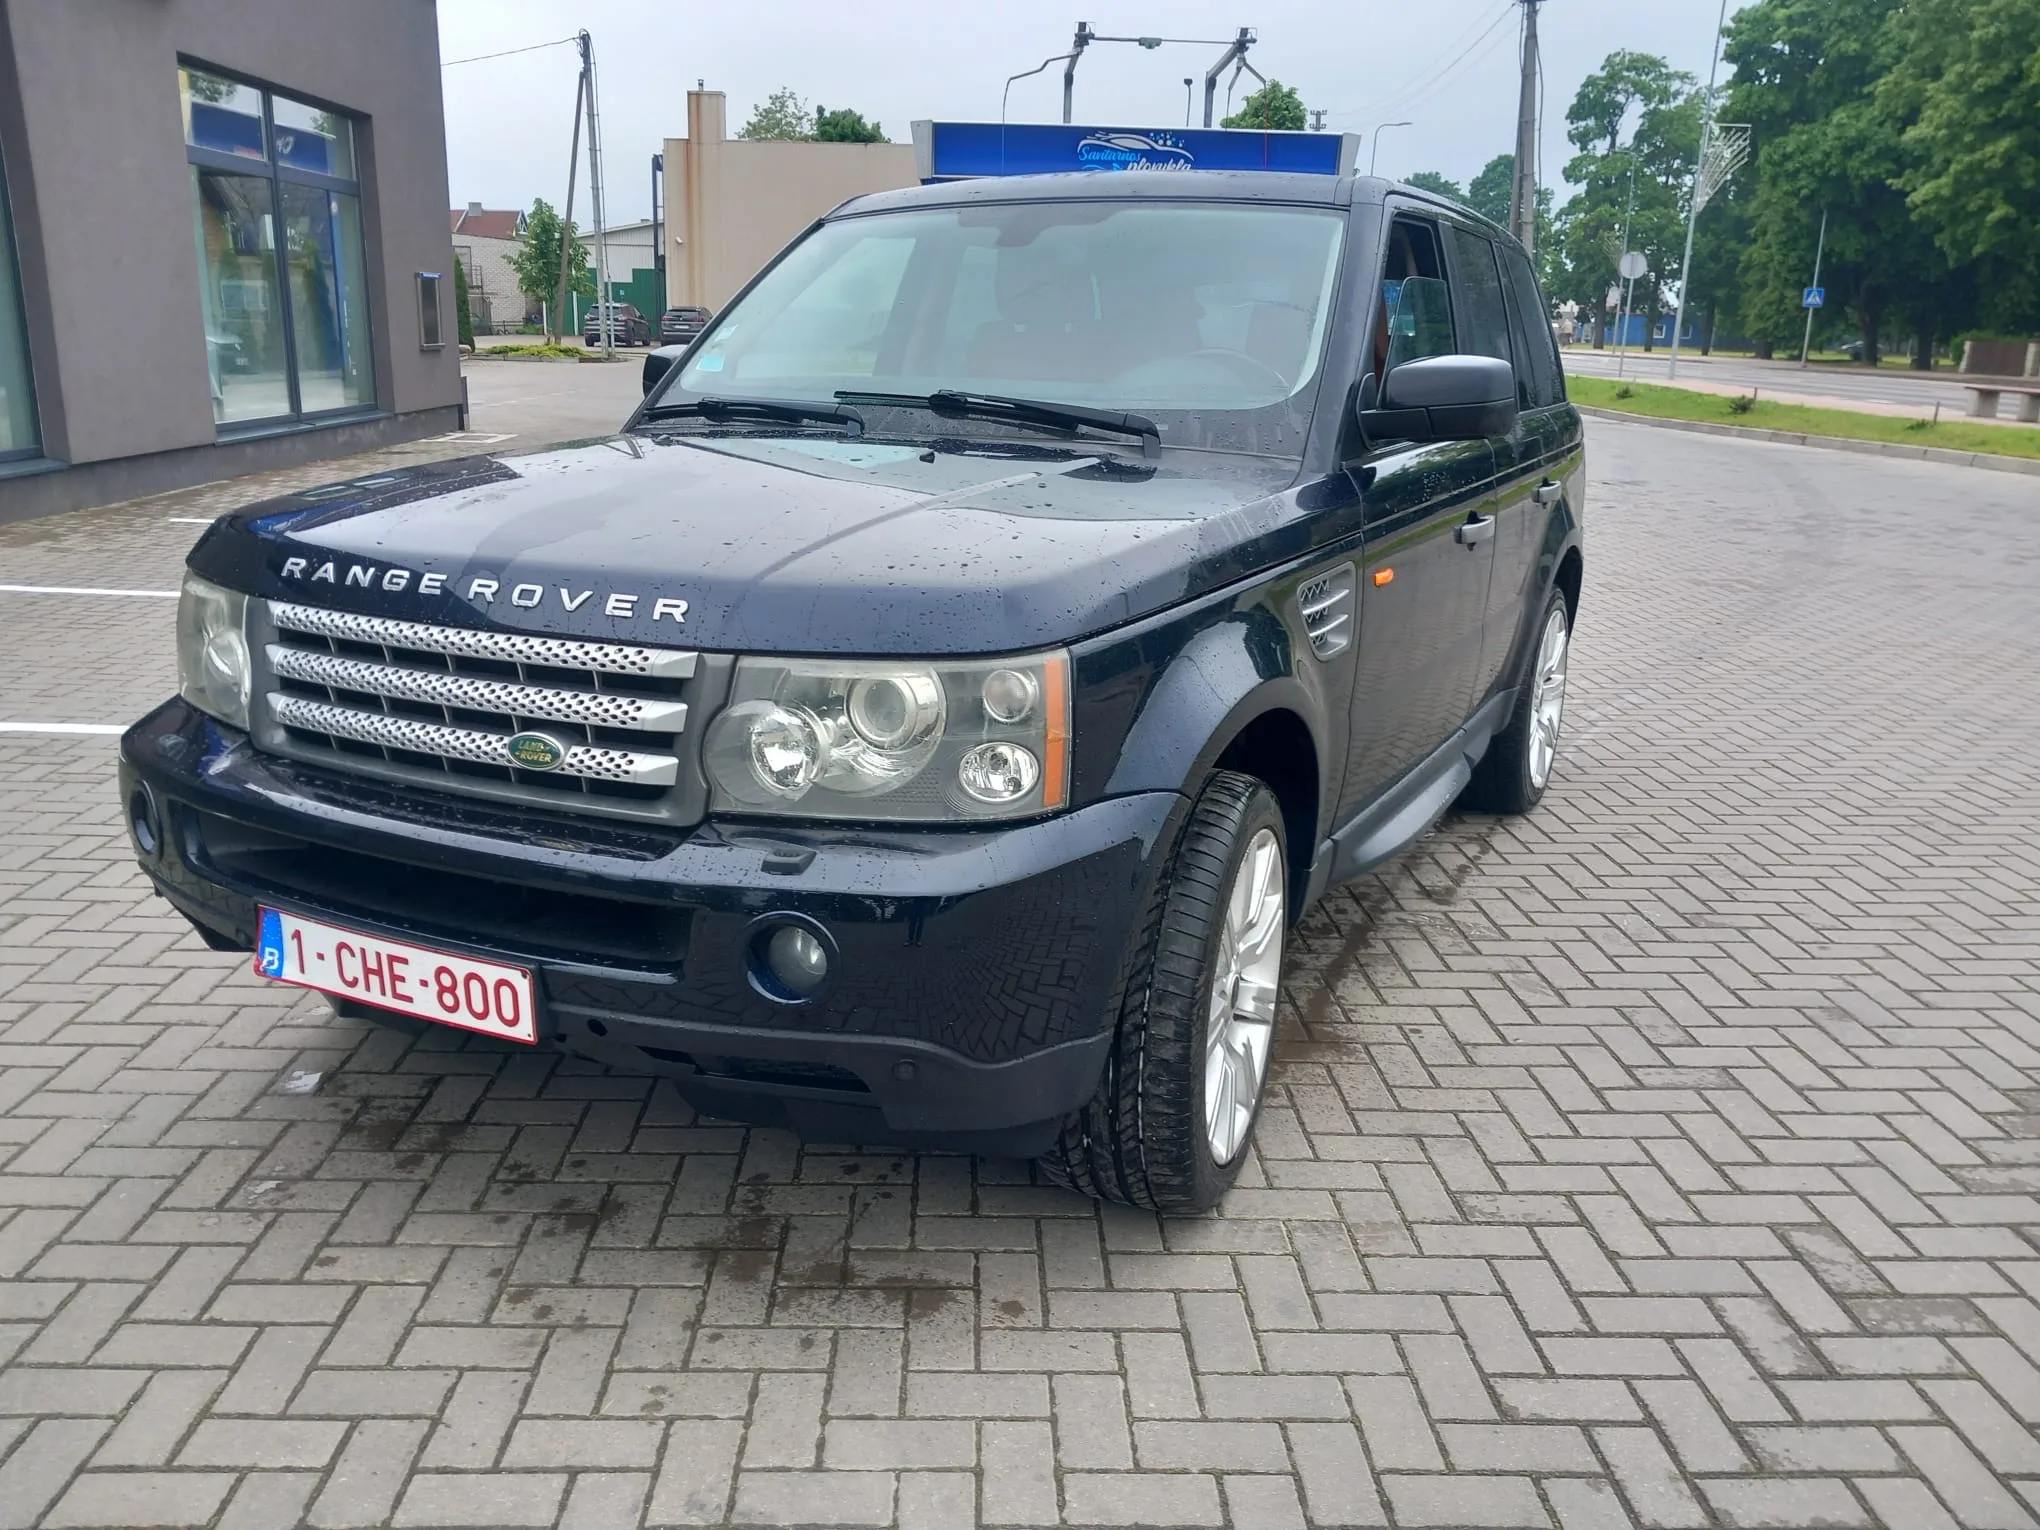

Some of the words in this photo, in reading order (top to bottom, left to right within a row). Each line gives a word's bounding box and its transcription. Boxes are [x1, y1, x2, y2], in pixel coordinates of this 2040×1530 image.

[281, 556, 448, 596] RANGE
[468, 578, 691, 624] ROVER
[520, 751, 552, 762] ROVER
[263, 946, 280, 970] B
[291, 928, 521, 1028] 1-CHE-800
